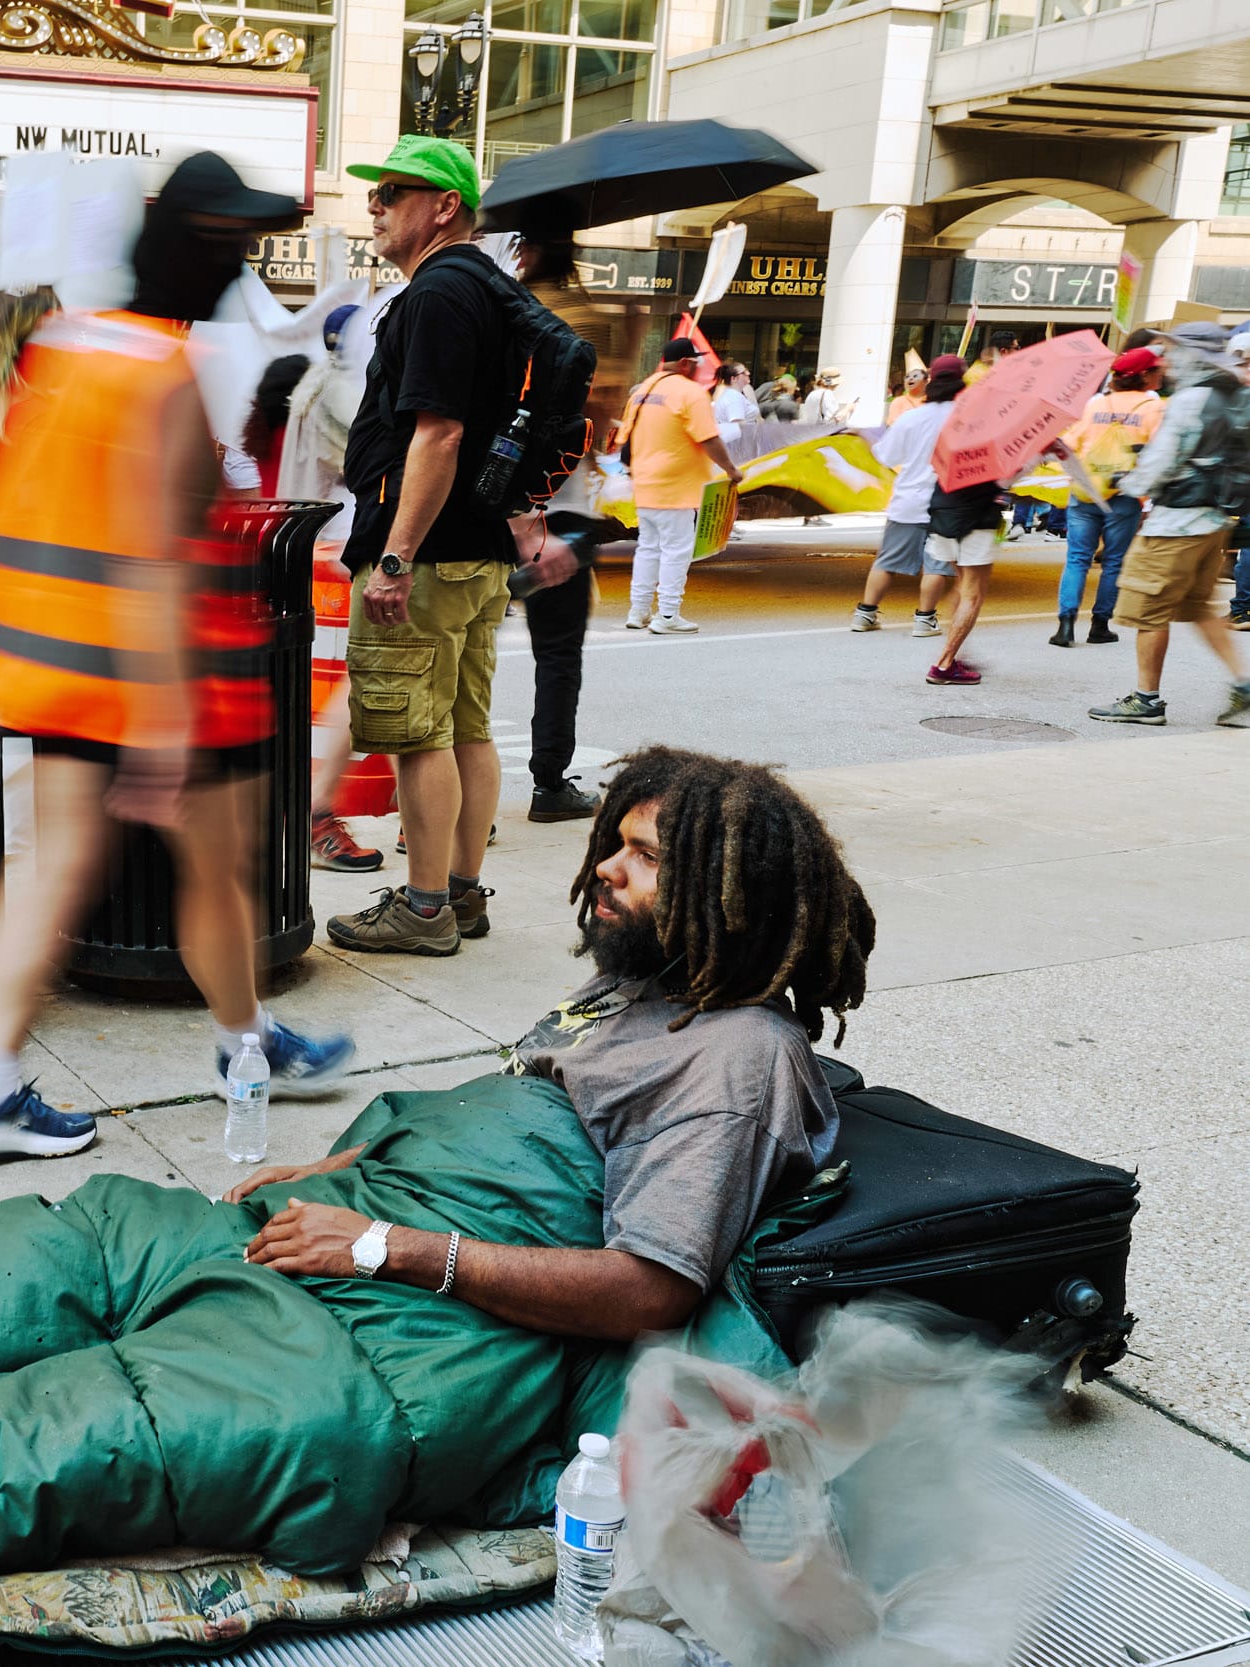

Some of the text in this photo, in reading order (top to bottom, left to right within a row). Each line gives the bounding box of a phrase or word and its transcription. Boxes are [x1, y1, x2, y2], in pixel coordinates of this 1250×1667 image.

[16, 126, 48, 151] NW
[61, 128, 161, 158] MUTUAL,
[266, 263, 318, 280] CIGAR
[750, 256, 827, 281] UHL
[727, 281, 768, 295] INEST
[771, 281, 818, 296] CIGARS
[1003, 411, 1056, 457] RACISM
